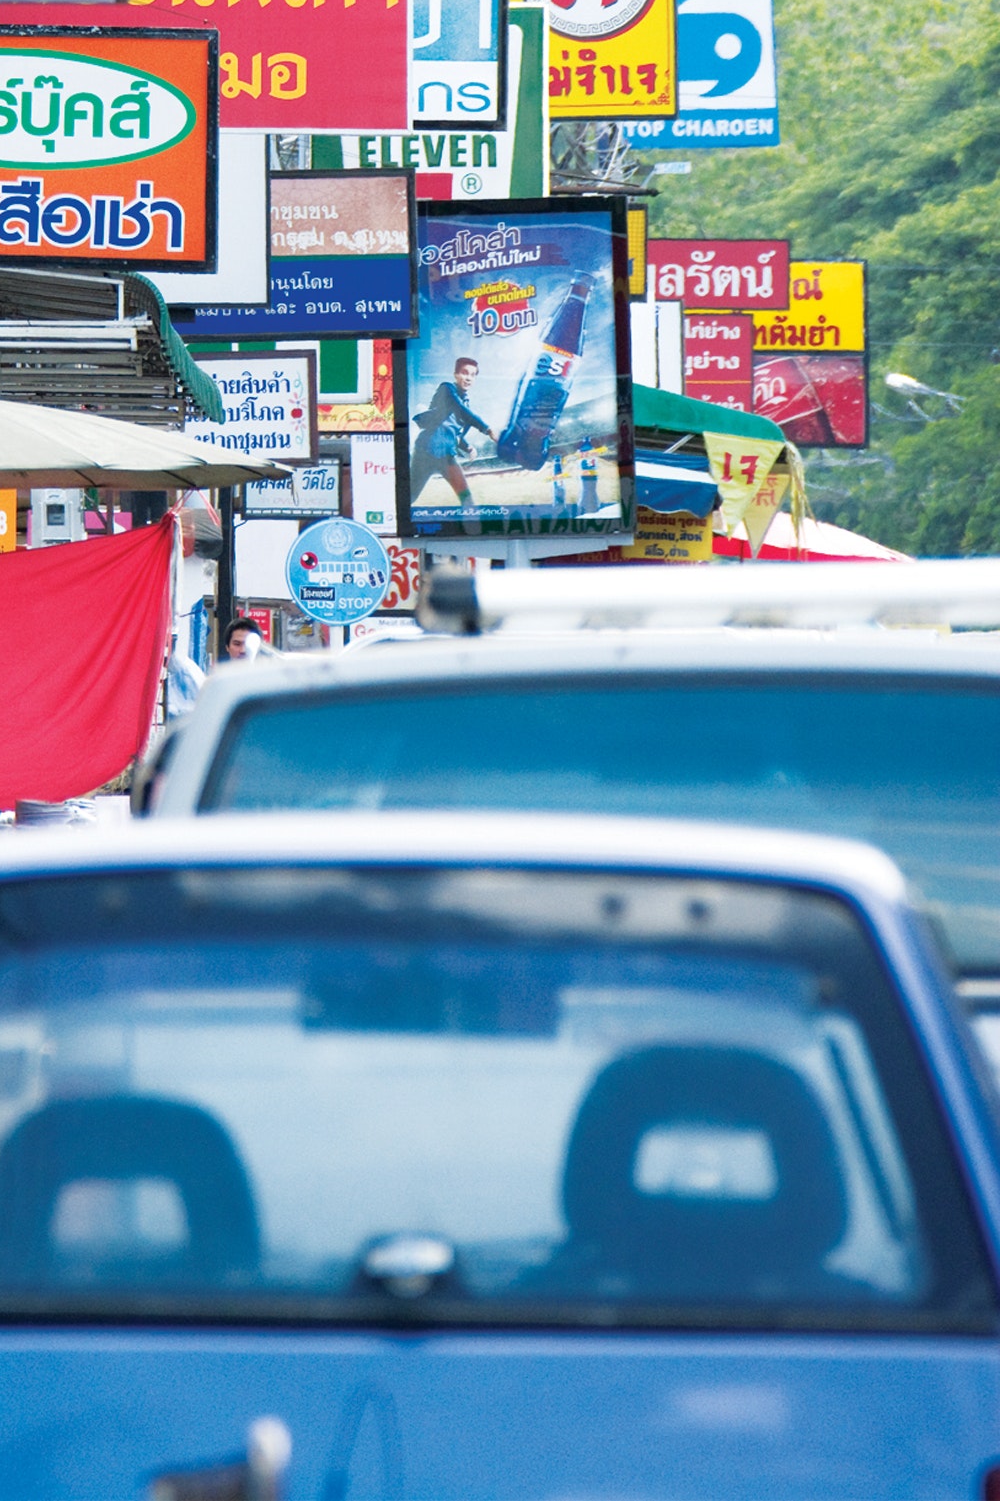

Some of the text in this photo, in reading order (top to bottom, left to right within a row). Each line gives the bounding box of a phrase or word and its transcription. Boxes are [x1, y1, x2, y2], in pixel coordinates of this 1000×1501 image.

[672, 117, 774, 138] CHAROEN
[467, 307, 499, 337] 10
[338, 598, 373, 610] STOP
